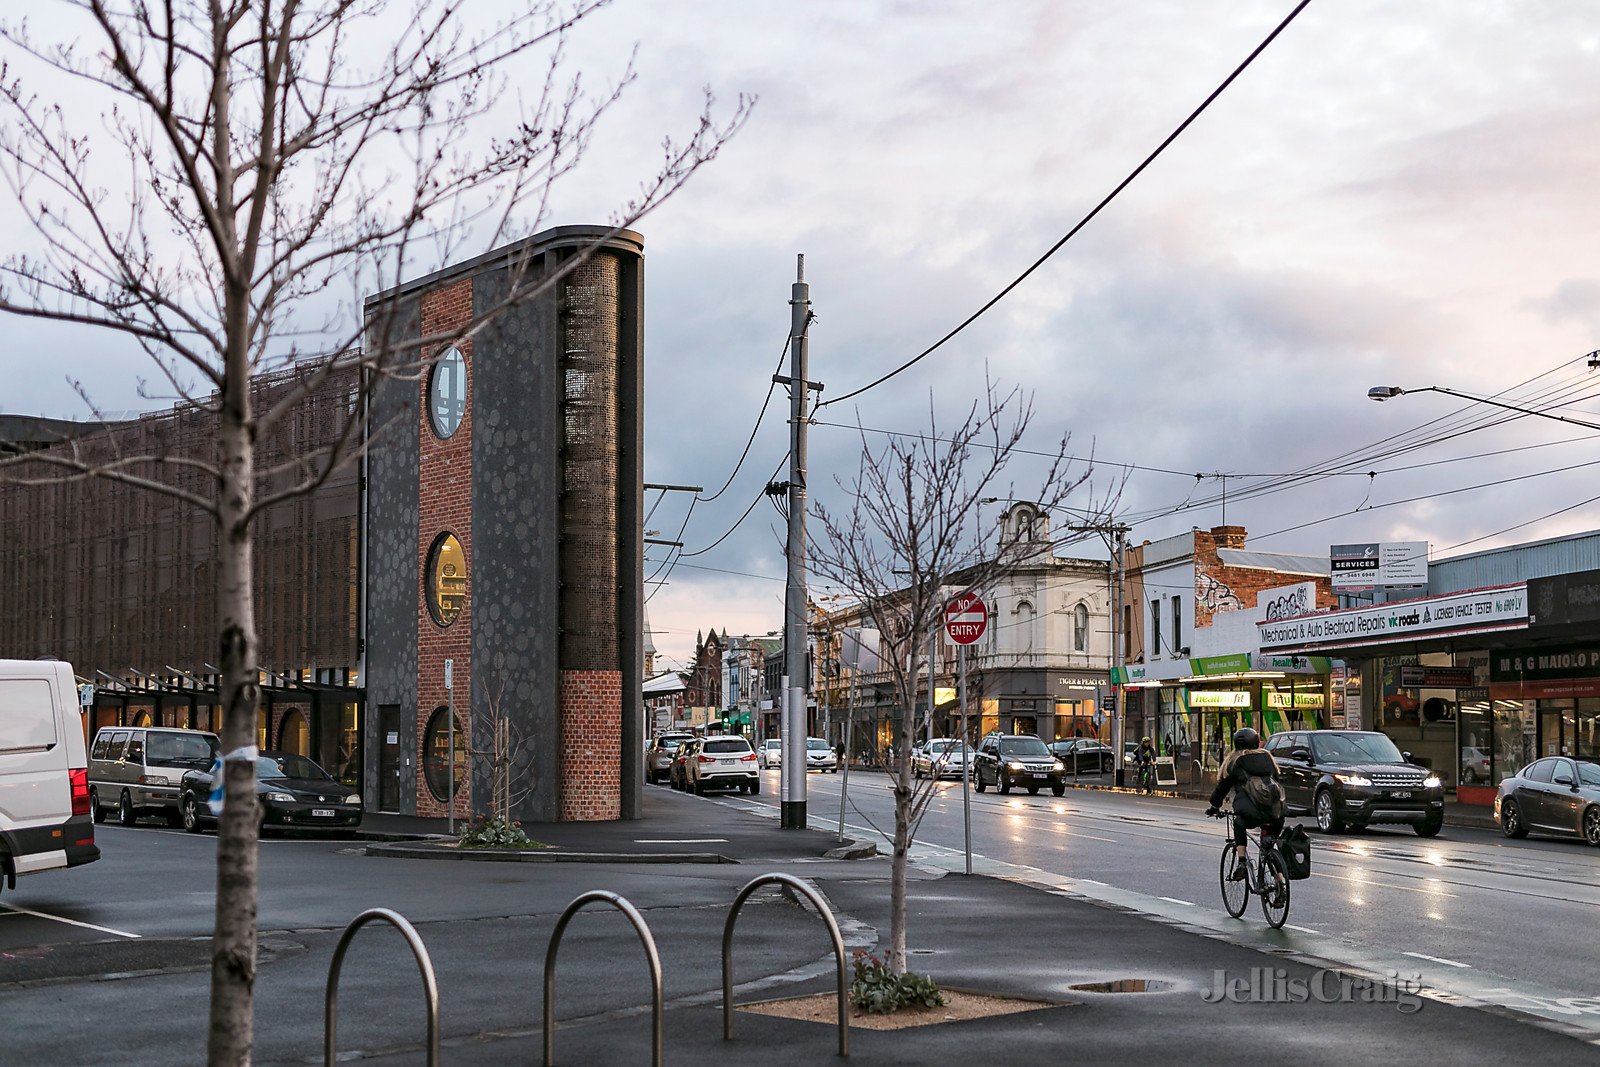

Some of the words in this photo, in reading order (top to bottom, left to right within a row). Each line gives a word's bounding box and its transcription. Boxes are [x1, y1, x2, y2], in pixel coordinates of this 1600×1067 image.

[958, 599, 970, 610] NO
[1261, 624, 1299, 642] Mechanical
[1300, 623, 1306, 638] &
[1307, 622, 1322, 638] Auto
[1324, 616, 1356, 636] Electrical
[1358, 614, 1386, 634] Repairs
[1434, 606, 1454, 620] LICENSED
[1454, 604, 1472, 617] VEHICLE
[1475, 601, 1492, 615] TESTER
[950, 624, 980, 636] ENTRY
[1500, 659, 1510, 672] M
[1514, 658, 1522, 670] &
[1526, 656, 1534, 669] G
[1539, 652, 1586, 669] MAIOLO
[1460, 690, 1487, 698] SERVICE
